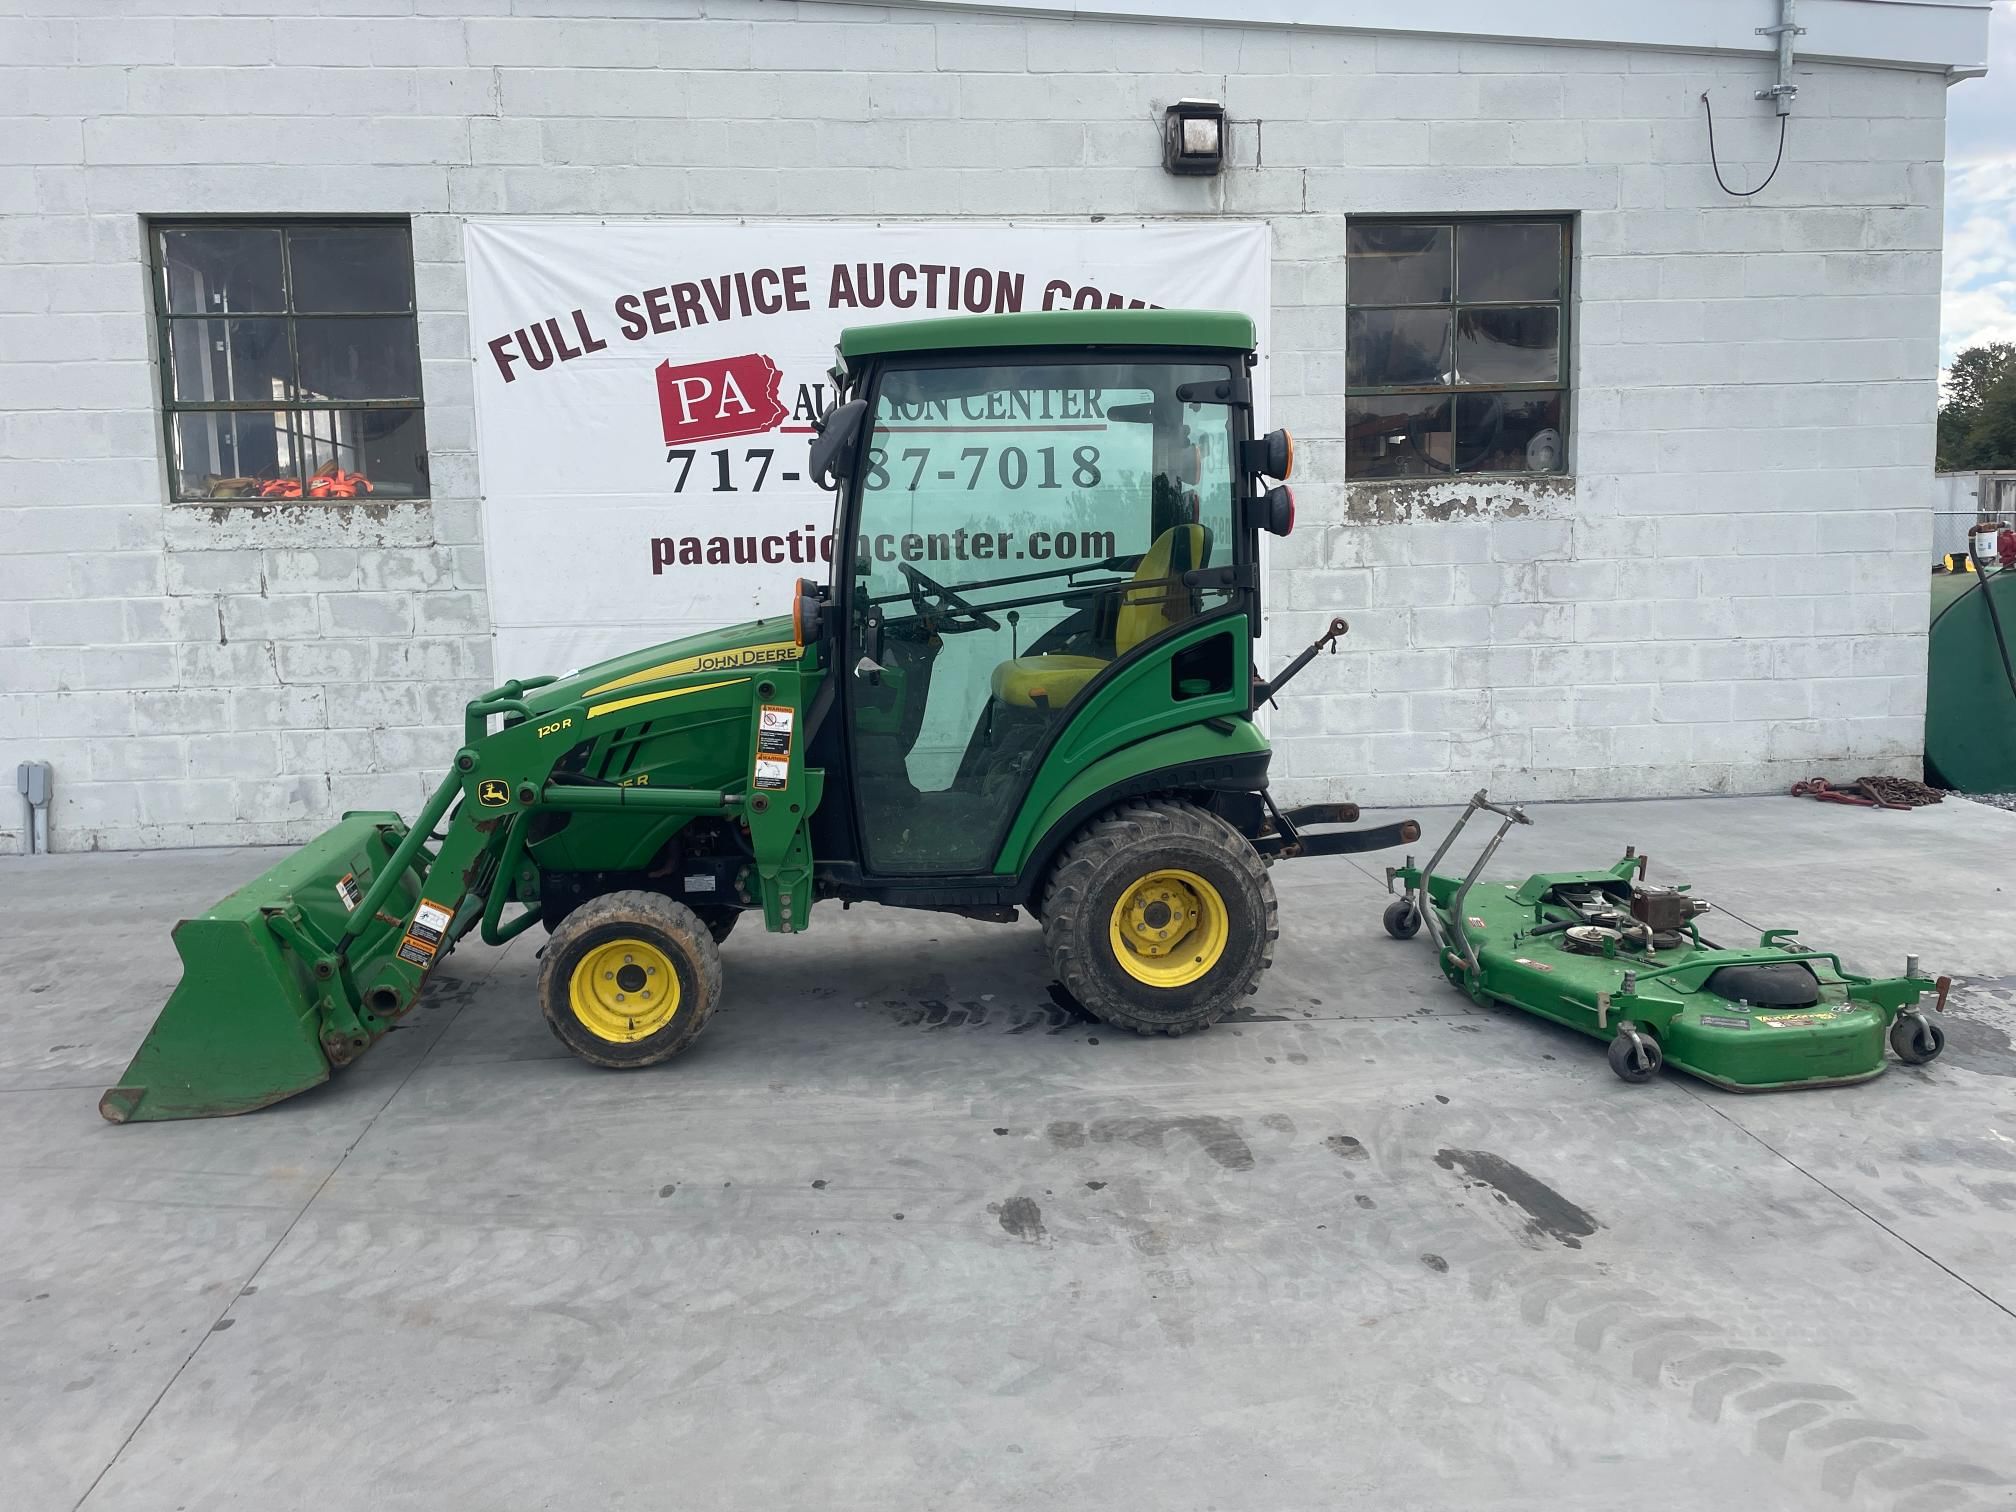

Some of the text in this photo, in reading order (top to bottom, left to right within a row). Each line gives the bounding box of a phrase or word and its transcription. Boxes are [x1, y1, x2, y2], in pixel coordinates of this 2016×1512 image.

[487, 308, 608, 383] FULL
[615, 265, 811, 341] SERVICE
[828, 262, 1025, 313] AUCTION
[671, 370, 756, 425] PA
[960, 386, 1105, 421] CENTER
[693, 648, 797, 672] JOHN DEERE
